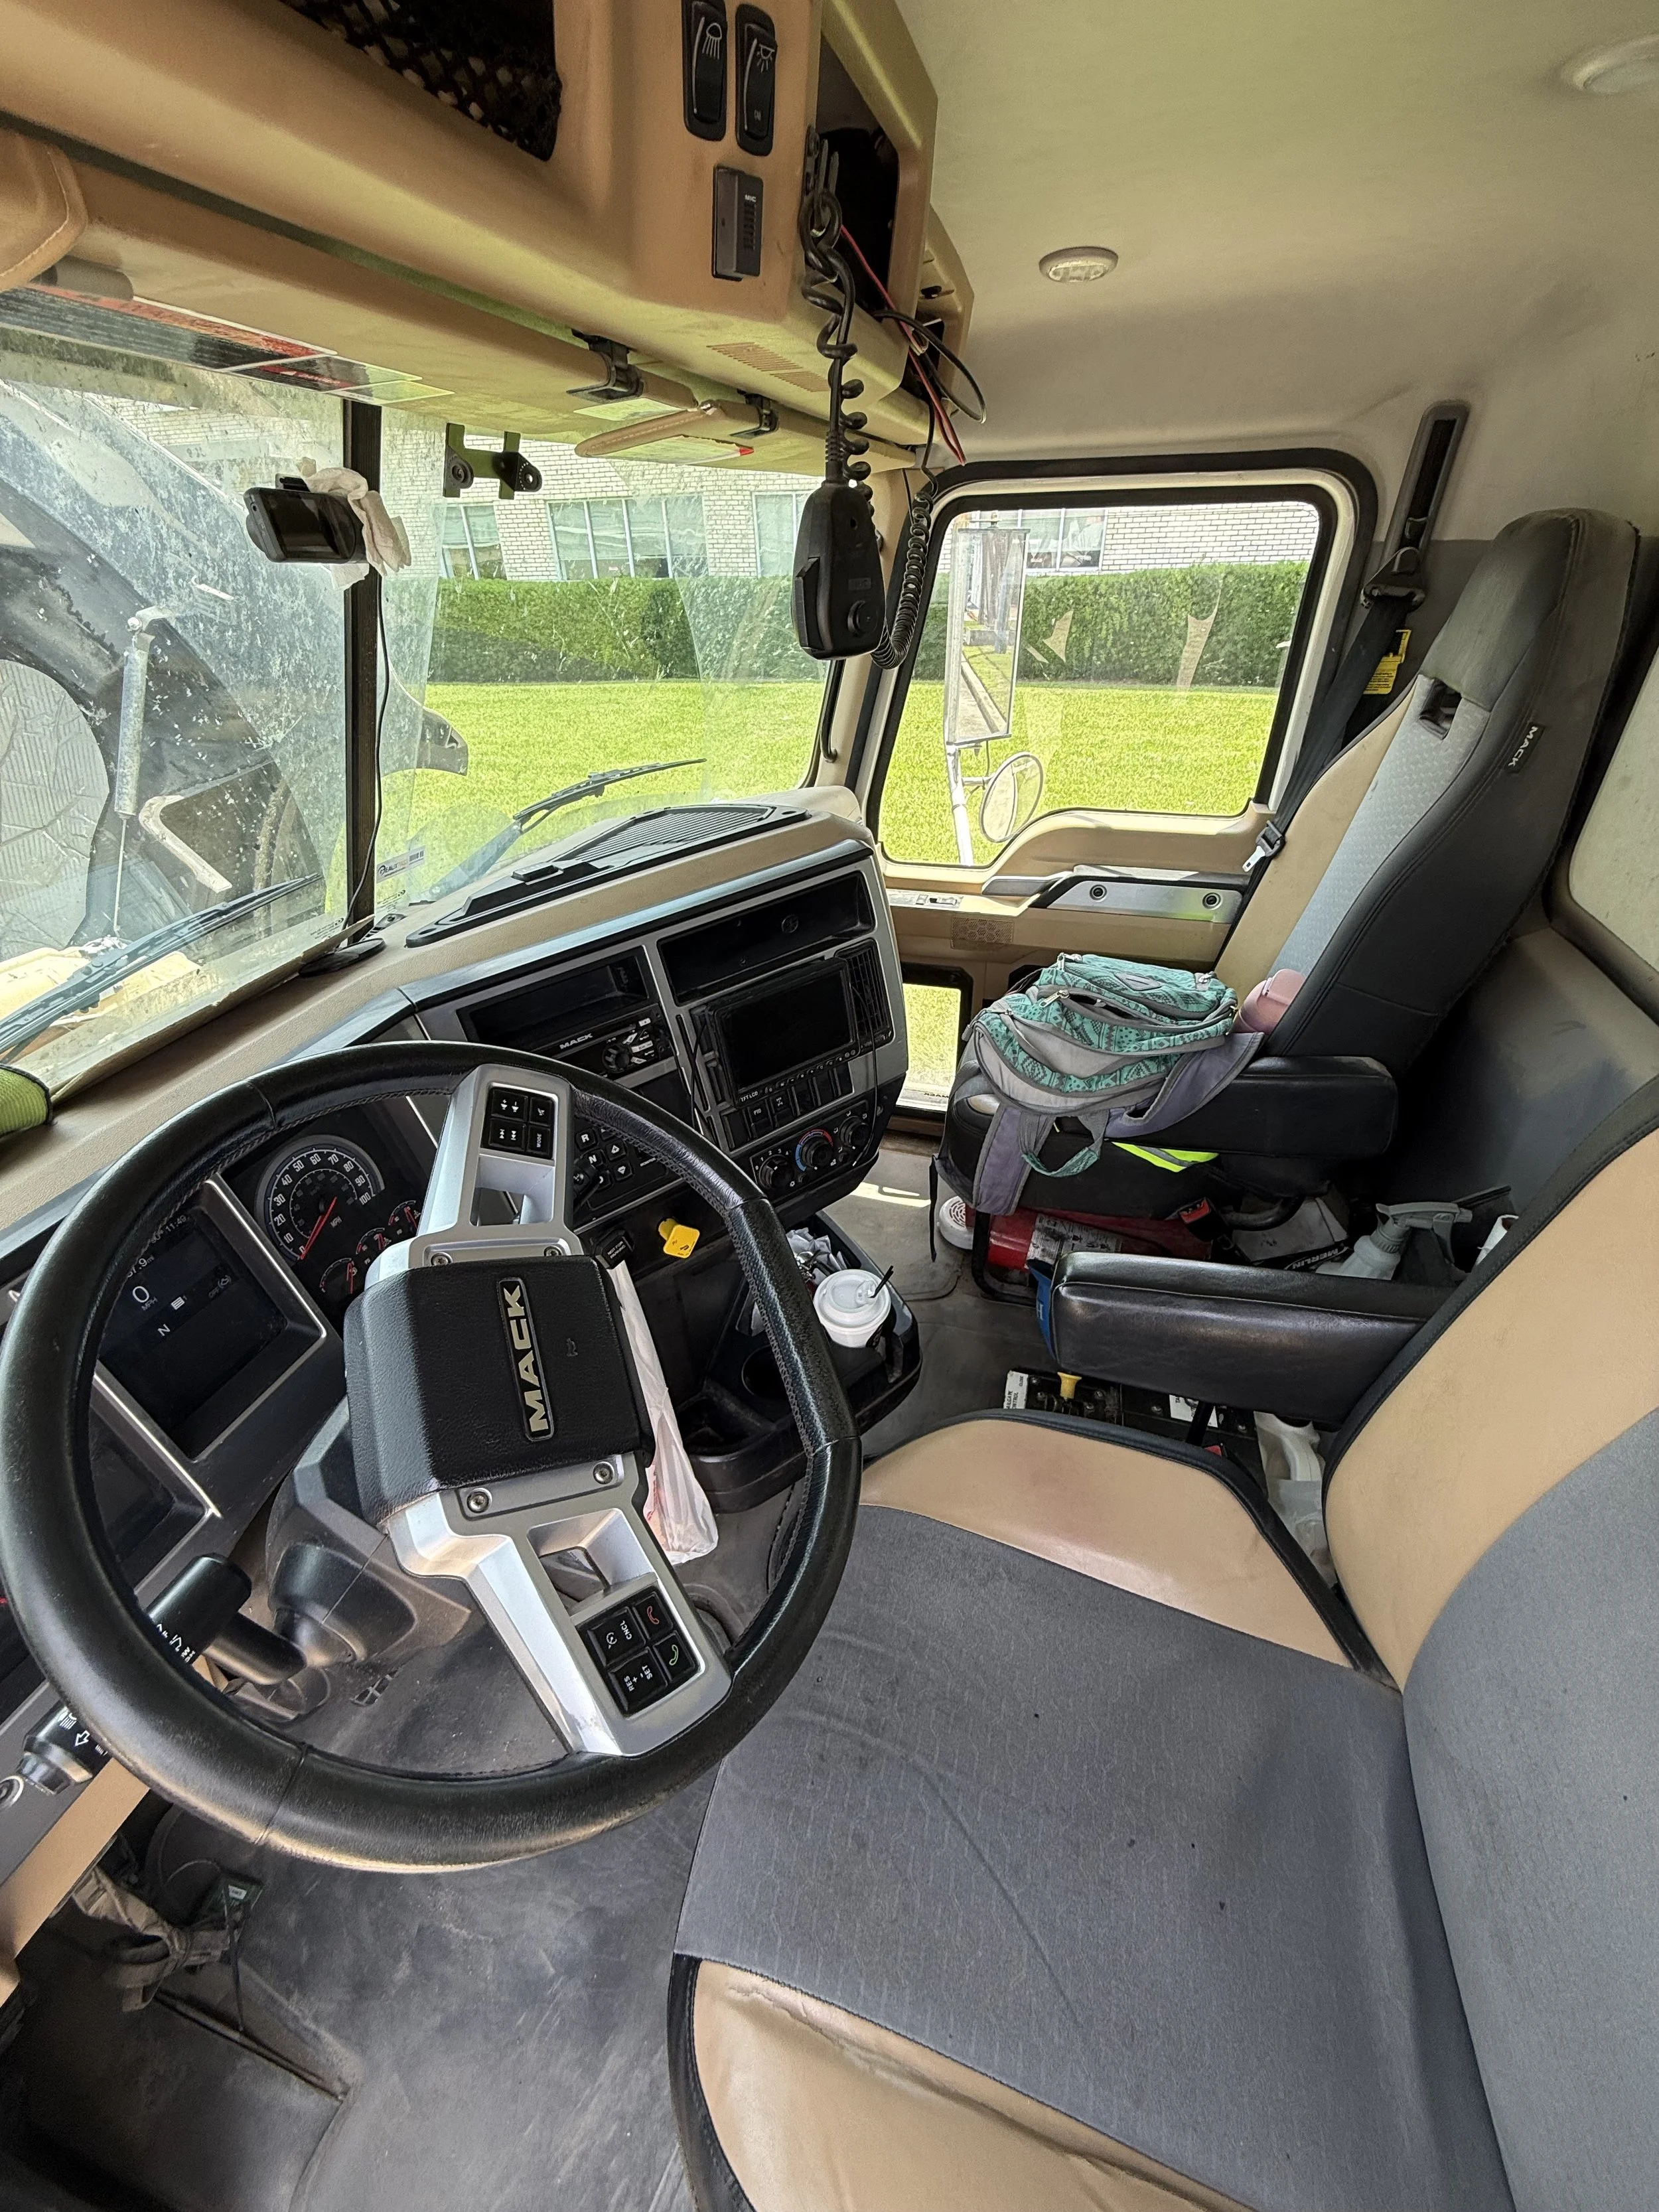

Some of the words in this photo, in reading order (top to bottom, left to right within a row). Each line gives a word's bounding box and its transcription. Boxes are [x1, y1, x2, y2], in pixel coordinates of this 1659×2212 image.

[744, 194, 757, 202] MIC
[1508, 726, 1538, 767] MACK
[559, 1033, 593, 1049] MACK
[581, 1134, 590, 1143] R
[309, 1153, 322, 1165] 60
[328, 1153, 340, 1165] 70
[589, 1155, 597, 1164] N
[293, 1160, 305, 1172] 50
[343, 1161, 354, 1173] 80
[281, 1174, 293, 1186] 40
[354, 1175, 366, 1187] 90
[273, 1193, 286, 1207] 30
[359, 1192, 372, 1205] 100
[165, 1215, 187, 1232] 11:49
[273, 1213, 286, 1226] 20
[330, 1216, 342, 1228] MPH
[283, 1232, 294, 1244] 10
[1292, 1248, 1338, 1270] MERLIN
[132, 1286, 149, 1303] 0
[141, 1297, 159, 1311] MPH
[157, 1323, 171, 1337] N
[503, 1285, 549, 1432] MACK
[619, 1620, 632, 1640] CNCL
[642, 1664, 653, 1680] SET
[624, 1675, 635, 1692] RES
